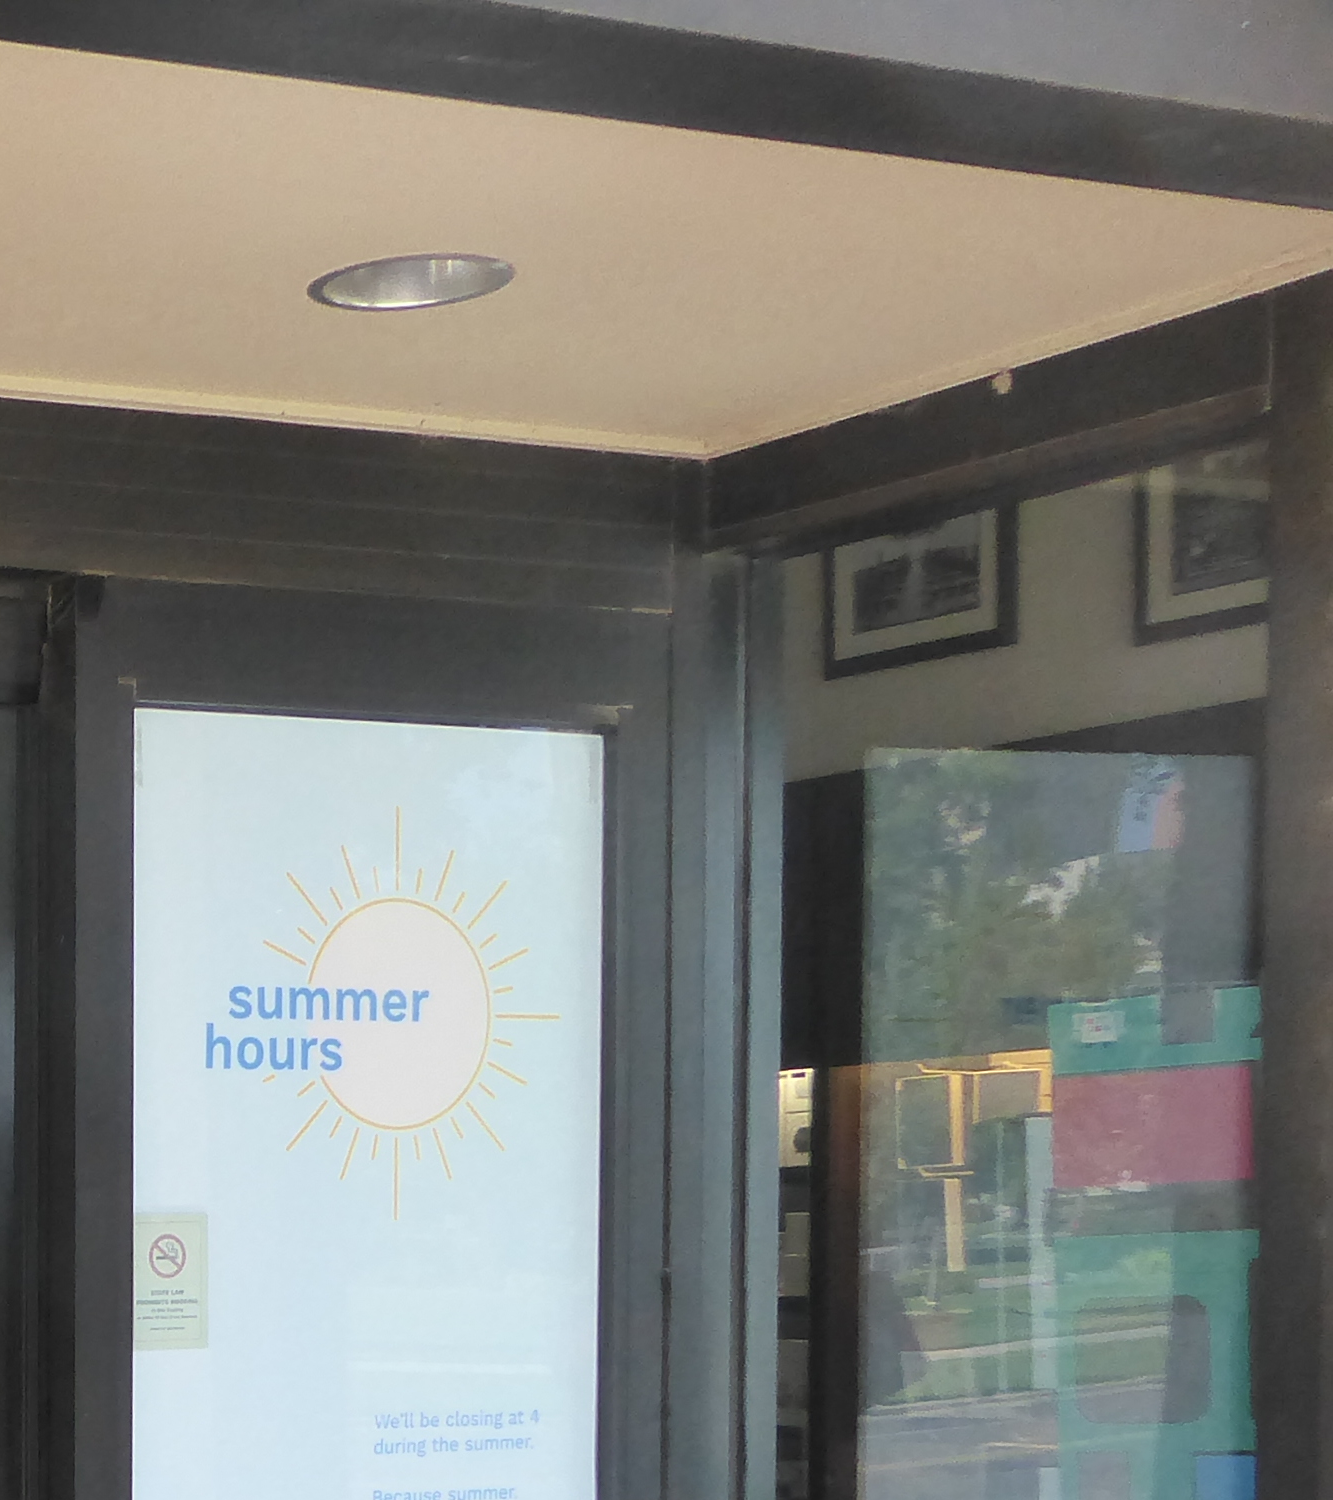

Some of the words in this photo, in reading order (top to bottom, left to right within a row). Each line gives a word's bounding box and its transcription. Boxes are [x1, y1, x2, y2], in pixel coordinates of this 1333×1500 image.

[228, 984, 429, 1023] summer
[205, 1022, 343, 1071] hours
[420, 1412, 440, 1428] be
[446, 1410, 503, 1429] closing
[508, 1411, 524, 1425] at
[530, 1409, 539, 1424] 4
[374, 1438, 427, 1457] during
[432, 1437, 459, 1452] the
[465, 1437, 534, 1451] summer.
